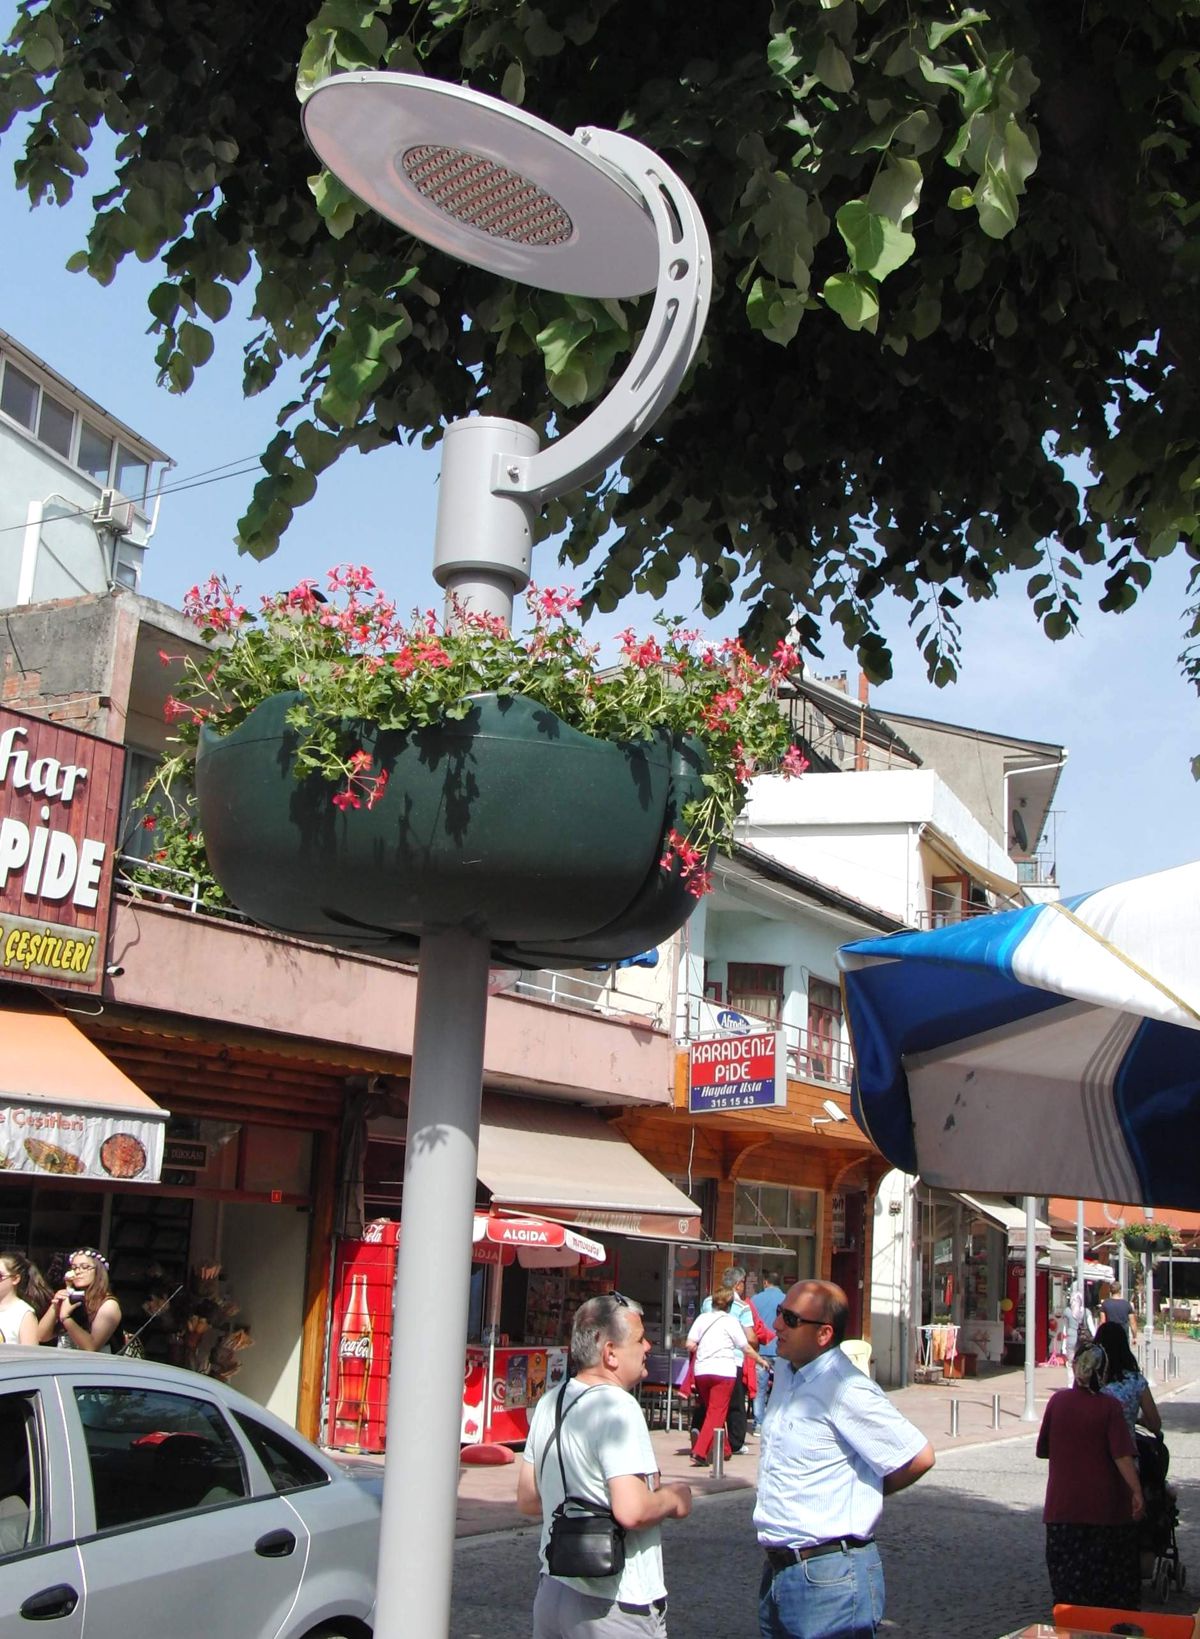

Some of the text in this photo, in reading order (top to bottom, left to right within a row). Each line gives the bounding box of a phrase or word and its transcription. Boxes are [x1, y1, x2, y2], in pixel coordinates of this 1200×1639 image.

[4, 927, 96, 974] ÇEŞİTLERİ
[710, 1096, 755, 1108] 315 15 43
[502, 1228, 548, 1243] ALGIDA
